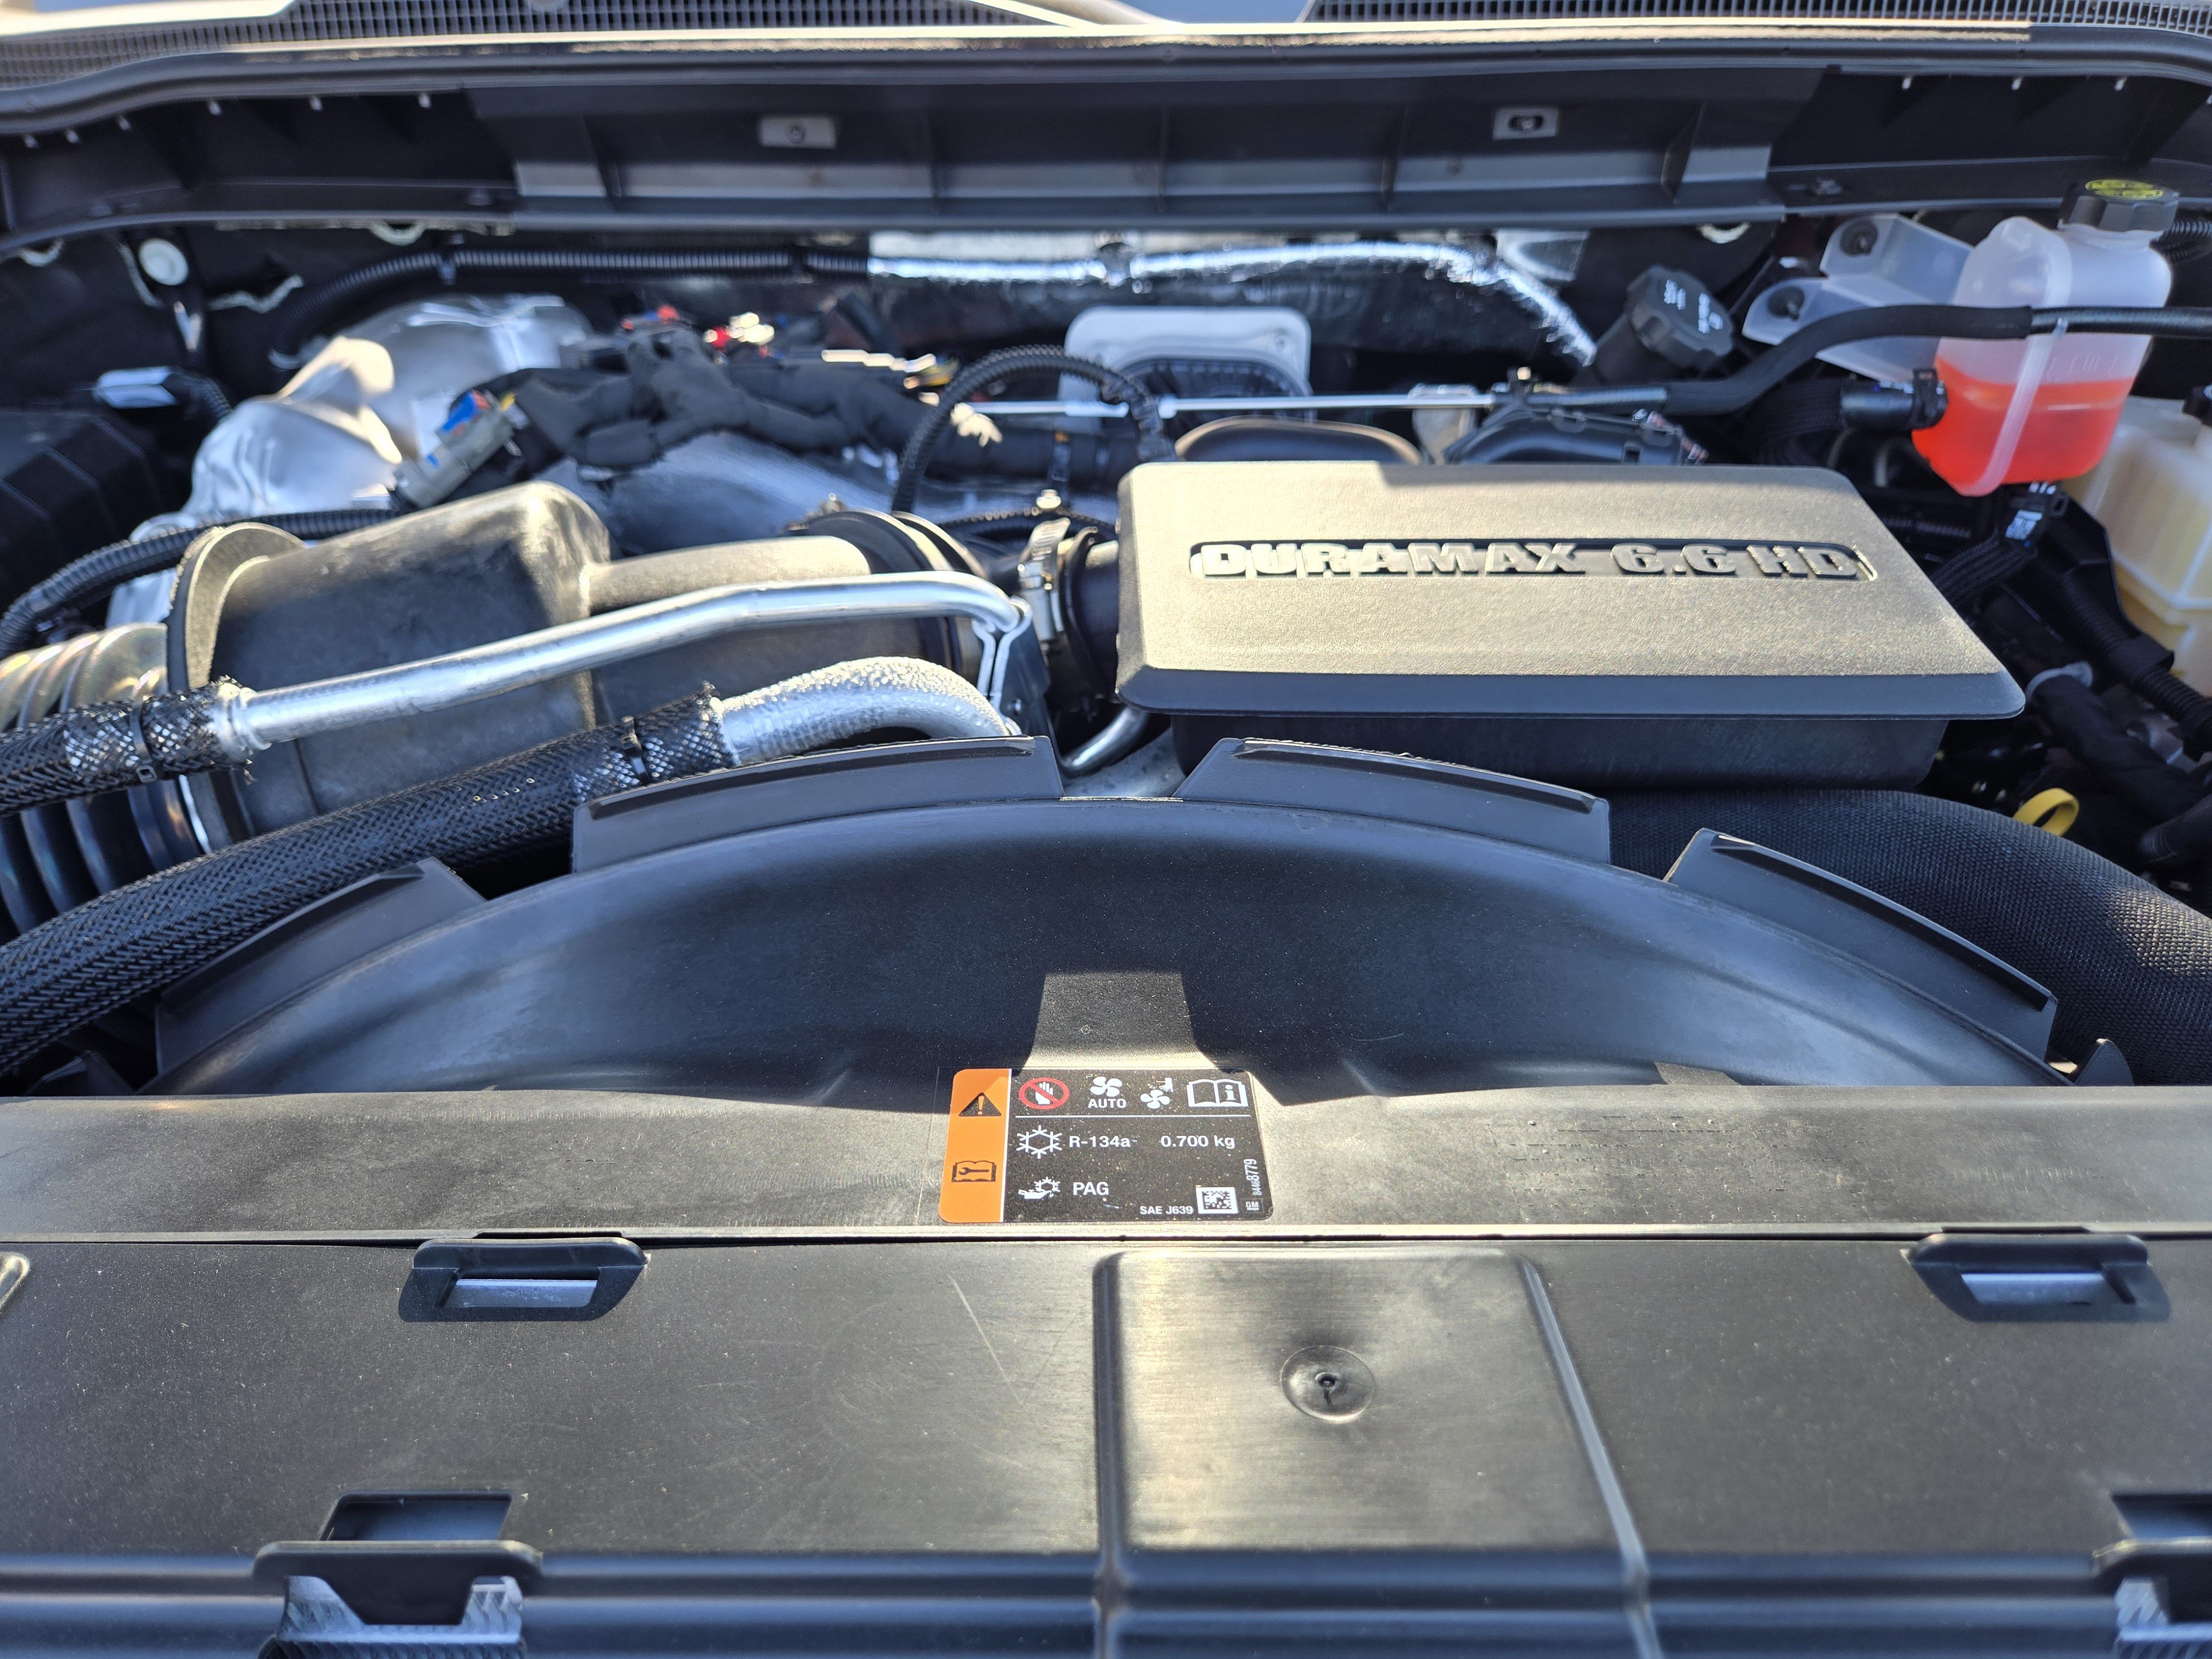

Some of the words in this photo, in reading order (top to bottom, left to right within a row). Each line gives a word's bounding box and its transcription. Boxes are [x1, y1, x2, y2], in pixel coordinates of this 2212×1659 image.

[1201, 543, 1585, 574] DURAMAX
[1610, 543, 1735, 575] 6.6
[1746, 544, 1857, 577] HD
[1088, 1098, 1126, 1109] AUTO
[1069, 1136, 1131, 1147] R-134a
[1161, 1135, 1208, 1147] 0.700
[1214, 1135, 1235, 1149] kg
[1073, 1182, 1109, 1195] PAG
[1140, 1206, 1163, 1214] SAE
[1166, 1206, 1193, 1214] J639
[1245, 1201, 1260, 1209] GM
